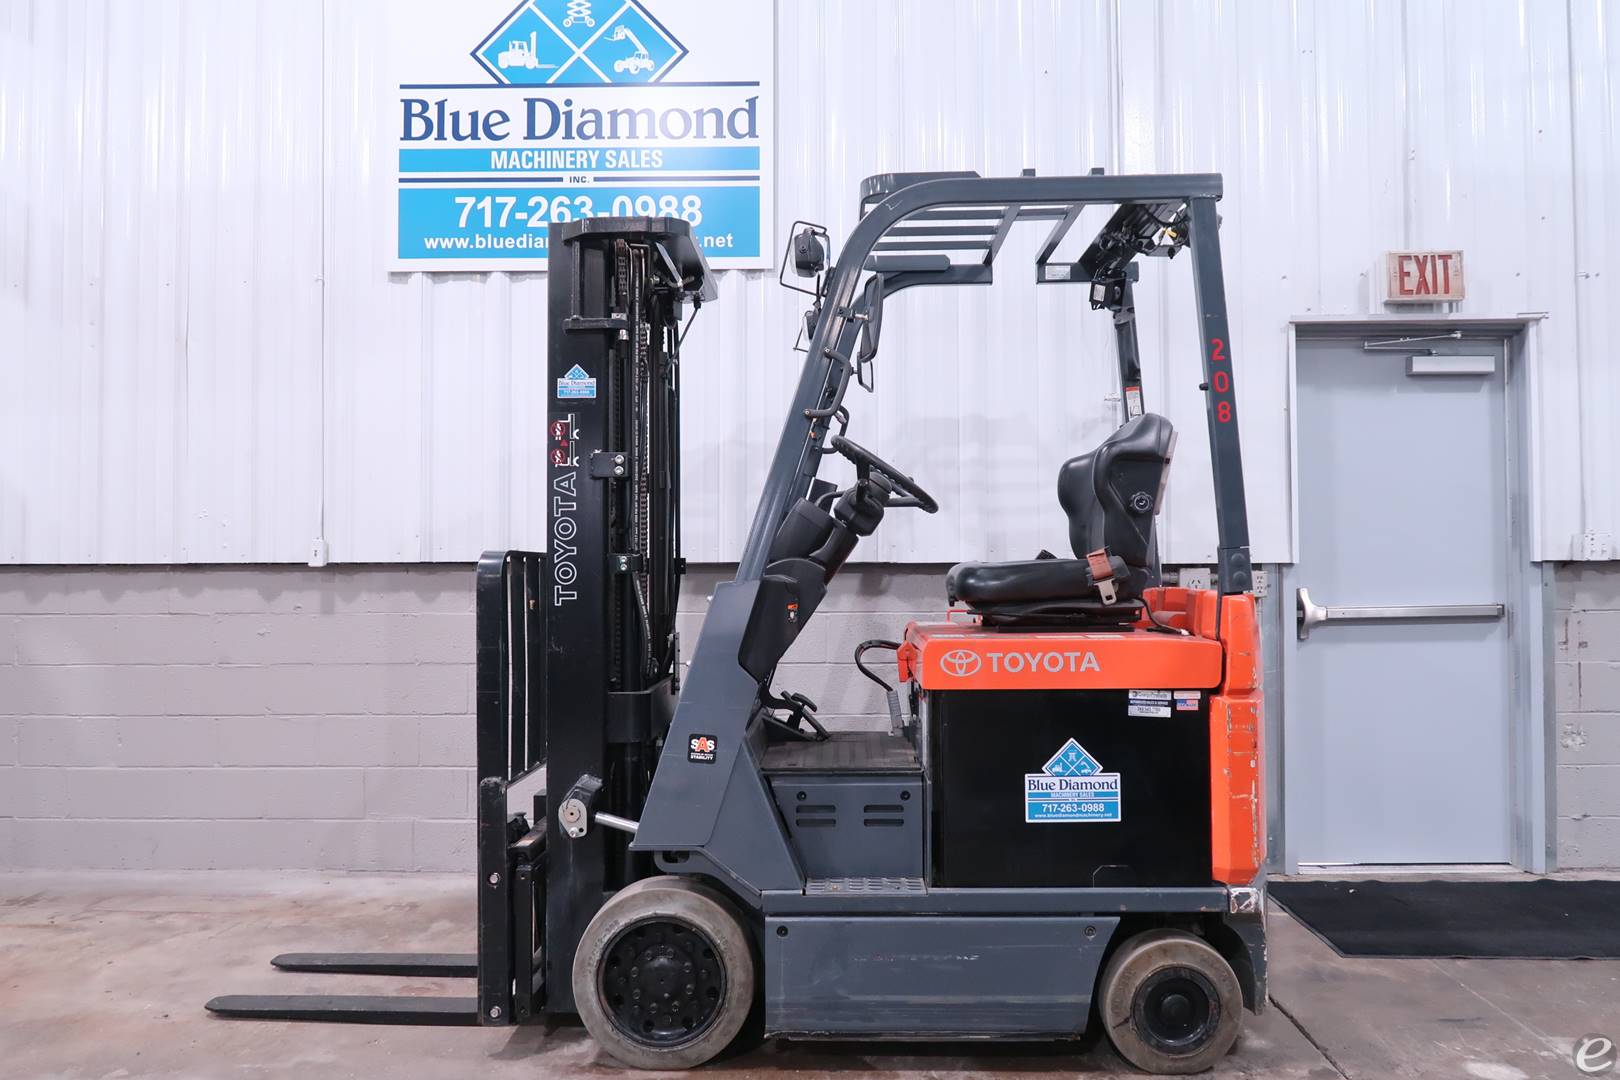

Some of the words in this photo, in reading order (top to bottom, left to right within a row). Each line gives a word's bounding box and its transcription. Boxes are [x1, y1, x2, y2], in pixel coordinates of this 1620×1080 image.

[400, 98, 510, 141] Blue
[523, 96, 759, 141] Diamond
[490, 150, 599, 169] MACHINERY
[605, 149, 663, 168] SALES
[569, 176, 590, 184] INC.
[454, 194, 702, 228] 717-263-0988
[1398, 254, 1452, 295] EXIT
[554, 471, 577, 606] TOYOTA
[987, 652, 1101, 673] TOYOTA
[690, 737, 715, 752] SAS
[1028, 779, 1056, 791] Blue
[1059, 779, 1118, 791] Diamond
[1042, 803, 1104, 813] 717-263-0988
